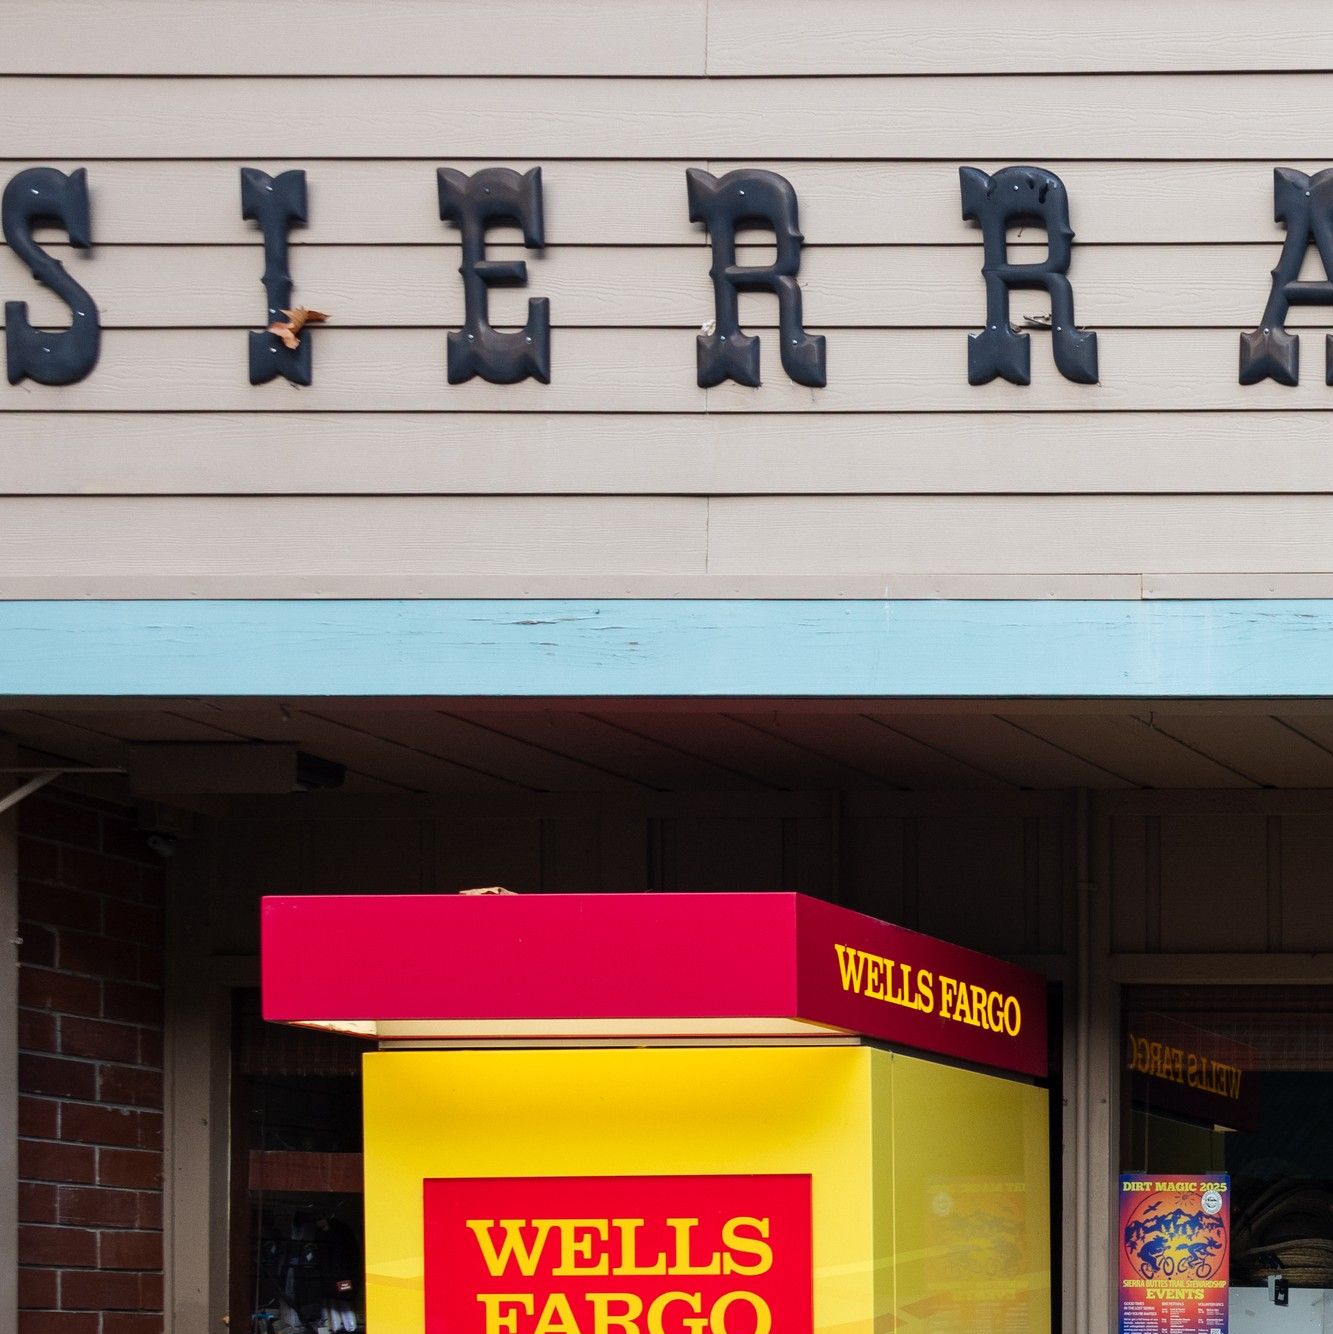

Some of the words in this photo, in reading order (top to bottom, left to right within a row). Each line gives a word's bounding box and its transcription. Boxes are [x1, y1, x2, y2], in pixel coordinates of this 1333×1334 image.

[834, 943, 934, 1012] WELLS
[938, 977, 1022, 1038] FARGO
[1123, 1182, 1152, 1191] DIRT
[1156, 1182, 1197, 1192] MAGIC
[1200, 1182, 1227, 1192] 2025
[465, 1215, 774, 1278] WELLS
[1187, 1280, 1227, 1288] STEWARDSHIP
[1146, 1289, 1204, 1299] EVENTS
